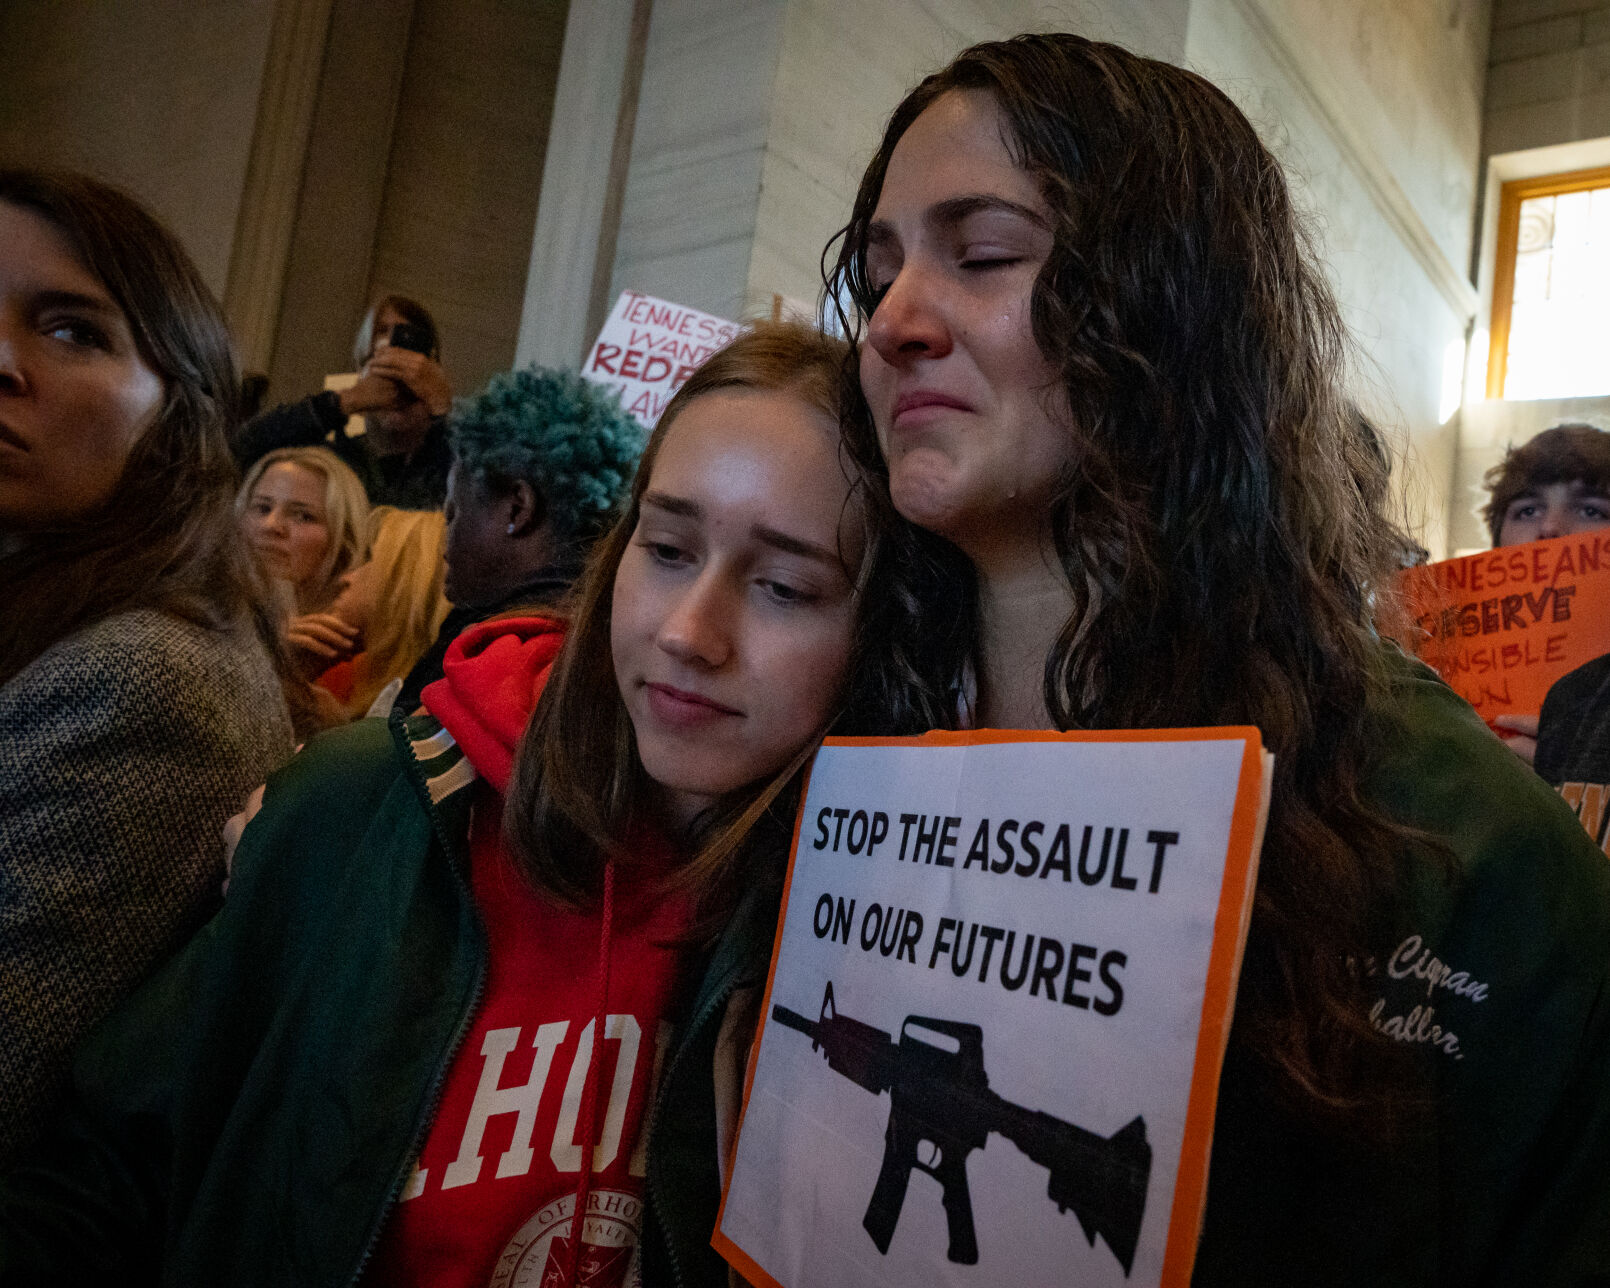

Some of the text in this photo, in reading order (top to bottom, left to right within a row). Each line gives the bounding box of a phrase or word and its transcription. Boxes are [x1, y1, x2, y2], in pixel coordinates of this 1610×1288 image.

[813, 806, 1180, 894] STOP THE ASSAULT
[813, 893, 1128, 1017] ON OUR FUTURES
[538, 1200, 568, 1225] OF
